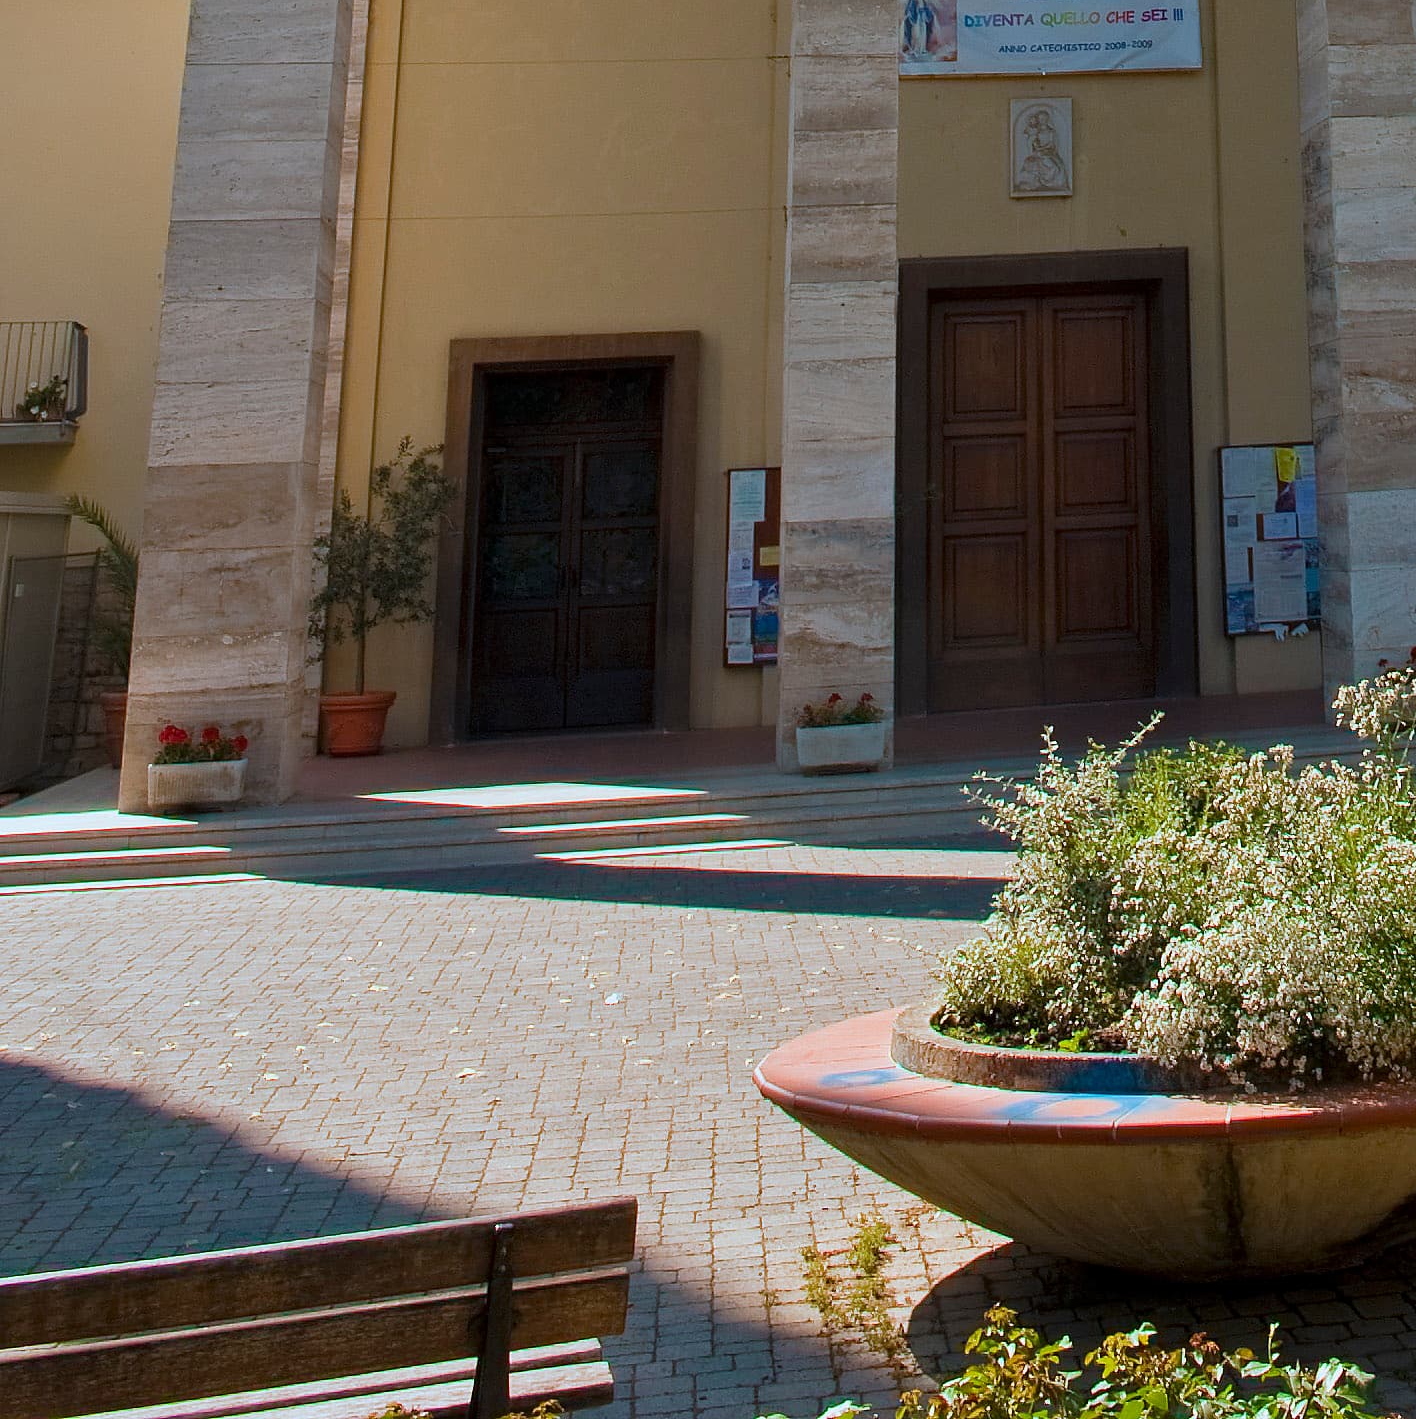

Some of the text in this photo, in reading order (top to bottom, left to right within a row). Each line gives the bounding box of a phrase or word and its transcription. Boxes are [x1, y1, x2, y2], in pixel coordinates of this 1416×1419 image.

[964, 13, 1035, 28] DIVENTA
[1040, 11, 1101, 28] QUELLO
[1106, 10, 1136, 24] CHE
[1141, 8, 1169, 22] SEI
[998, 39, 1153, 53] ANNO CATECHISTICO 2008-2009
